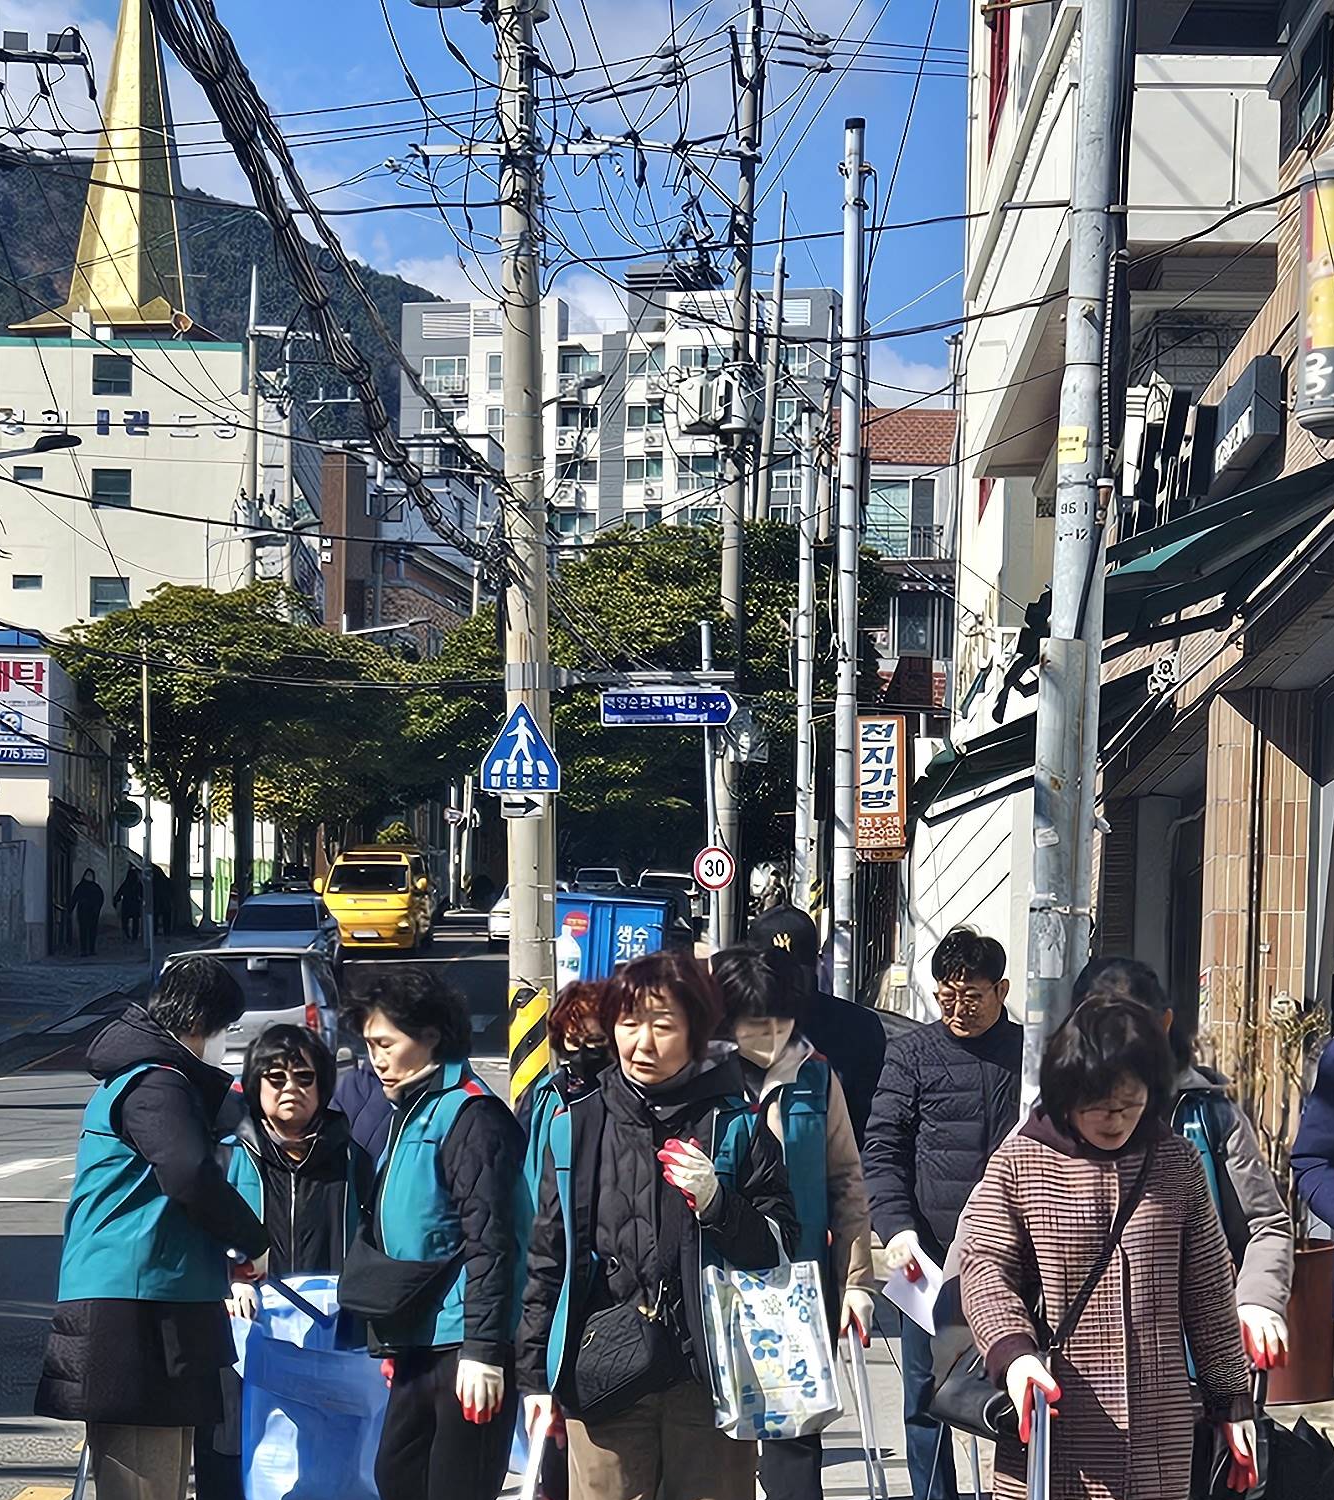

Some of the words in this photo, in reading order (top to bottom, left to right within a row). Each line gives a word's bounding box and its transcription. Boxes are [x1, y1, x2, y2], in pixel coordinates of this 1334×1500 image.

[860, 723, 897, 809] 전지가방
[704, 859, 725, 877] 30
[616, 925, 649, 943] 생수
